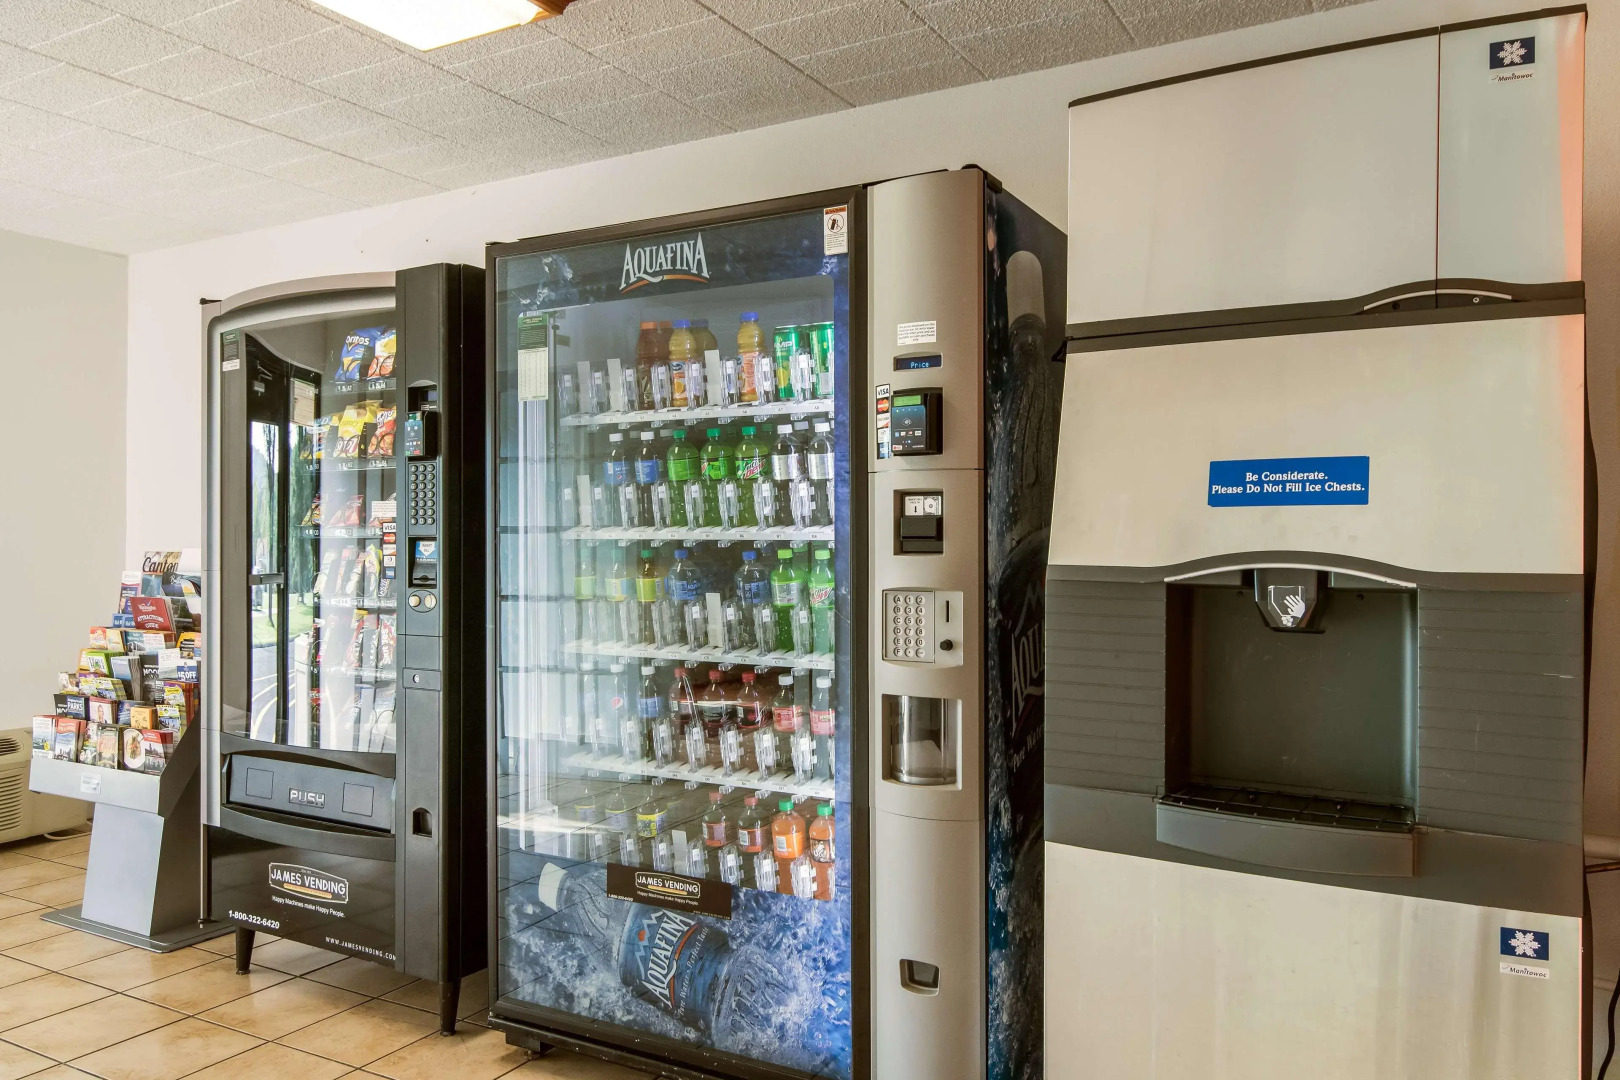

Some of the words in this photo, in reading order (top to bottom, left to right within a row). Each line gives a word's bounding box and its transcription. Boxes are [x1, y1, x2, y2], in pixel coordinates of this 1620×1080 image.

[1497, 72, 1534, 82] Manitowoc
[619, 231, 710, 290] AQUAFINA
[1245, 472, 1259, 482] Be
[1262, 471, 1328, 481] Considerate.
[1211, 484, 1243, 494] Please
[1246, 484, 1261, 493] Do
[1263, 483, 1283, 493] Not
[1285, 483, 1302, 492] Fill
[1305, 483, 1322, 492] Ice
[1324, 482, 1365, 492] Chests.
[142, 557, 179, 573] Canton
[68, 702, 83, 710] PARKS
[290, 790, 325, 802] PUSH
[271, 868, 302, 885] JAMES
[304, 875, 346, 895] VENDING
[637, 876, 663, 887] JAMES
[664, 880, 698, 893] VENDING
[271, 895, 284, 905] Happy
[285, 897, 304, 908] Machines
[304, 902, 315, 911] make
[316, 904, 329, 914] Happy
[228, 910, 280, 929] 1-800-322-6420
[687, 942, 701, 968] Perfect
[697, 926, 709, 942] Taste
[641, 908, 698, 1010] AQUAFINA
[1510, 968, 1547, 978] Manitowoc
